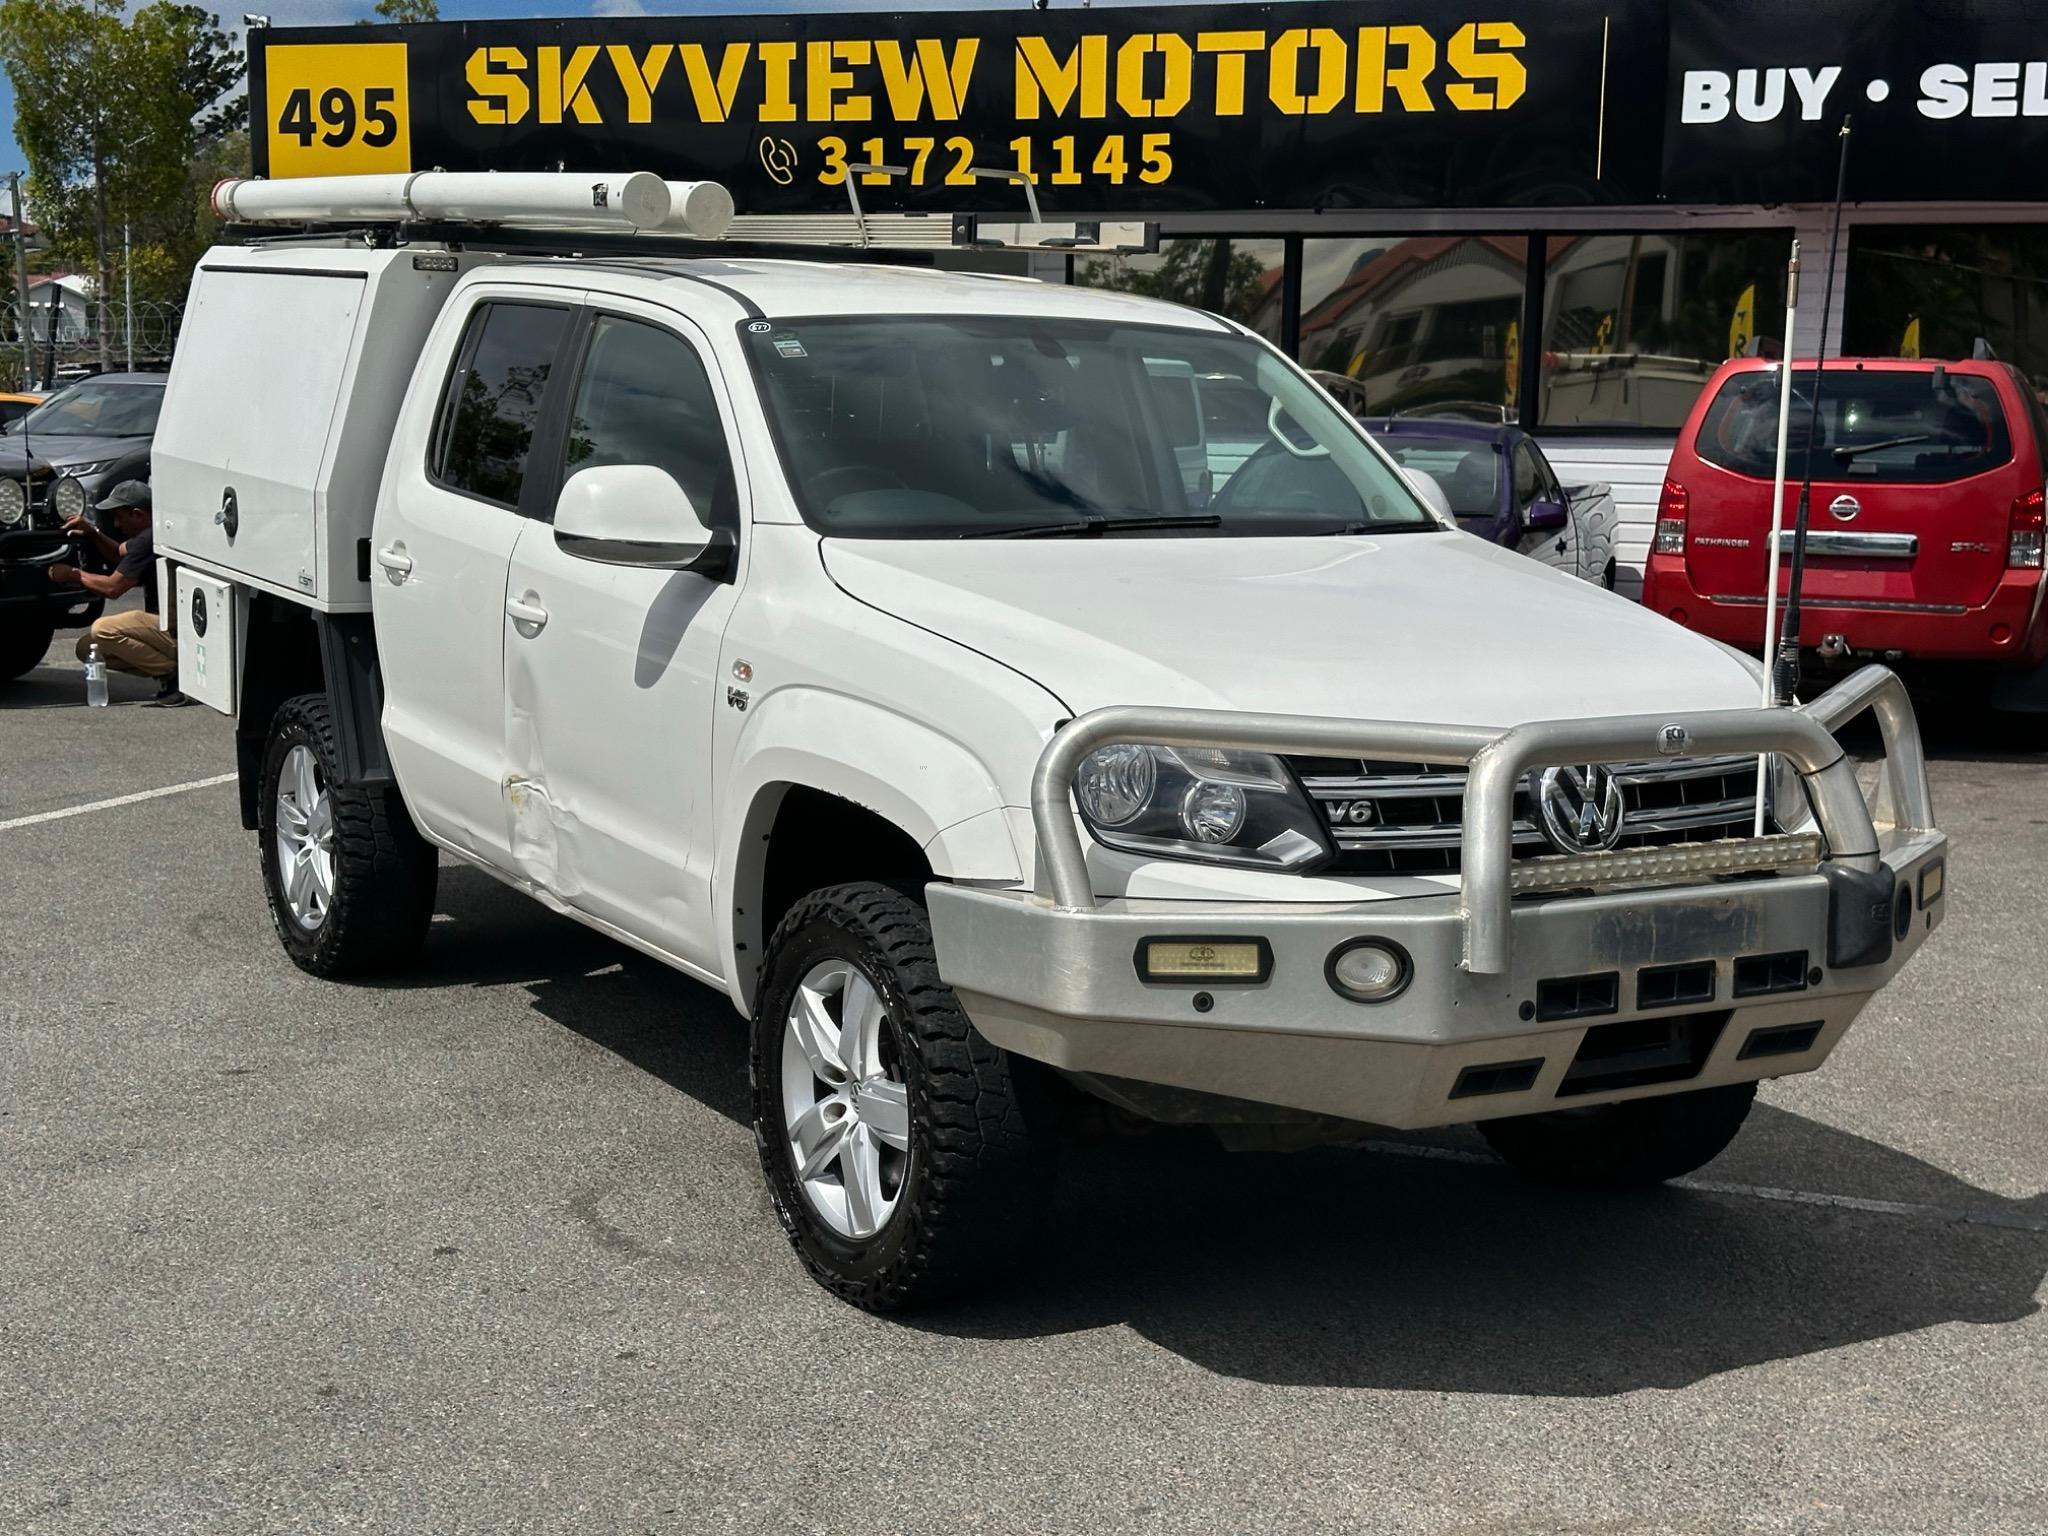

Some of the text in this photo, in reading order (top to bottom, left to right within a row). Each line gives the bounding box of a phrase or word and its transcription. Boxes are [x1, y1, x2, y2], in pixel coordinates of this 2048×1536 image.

[466, 21, 1529, 125] SKYVIEW MOTORS
[1681, 66, 1843, 124] BUY
[278, 87, 399, 149] 495
[817, 132, 1174, 187] 3172 1145
[1324, 800, 1372, 823] V6
